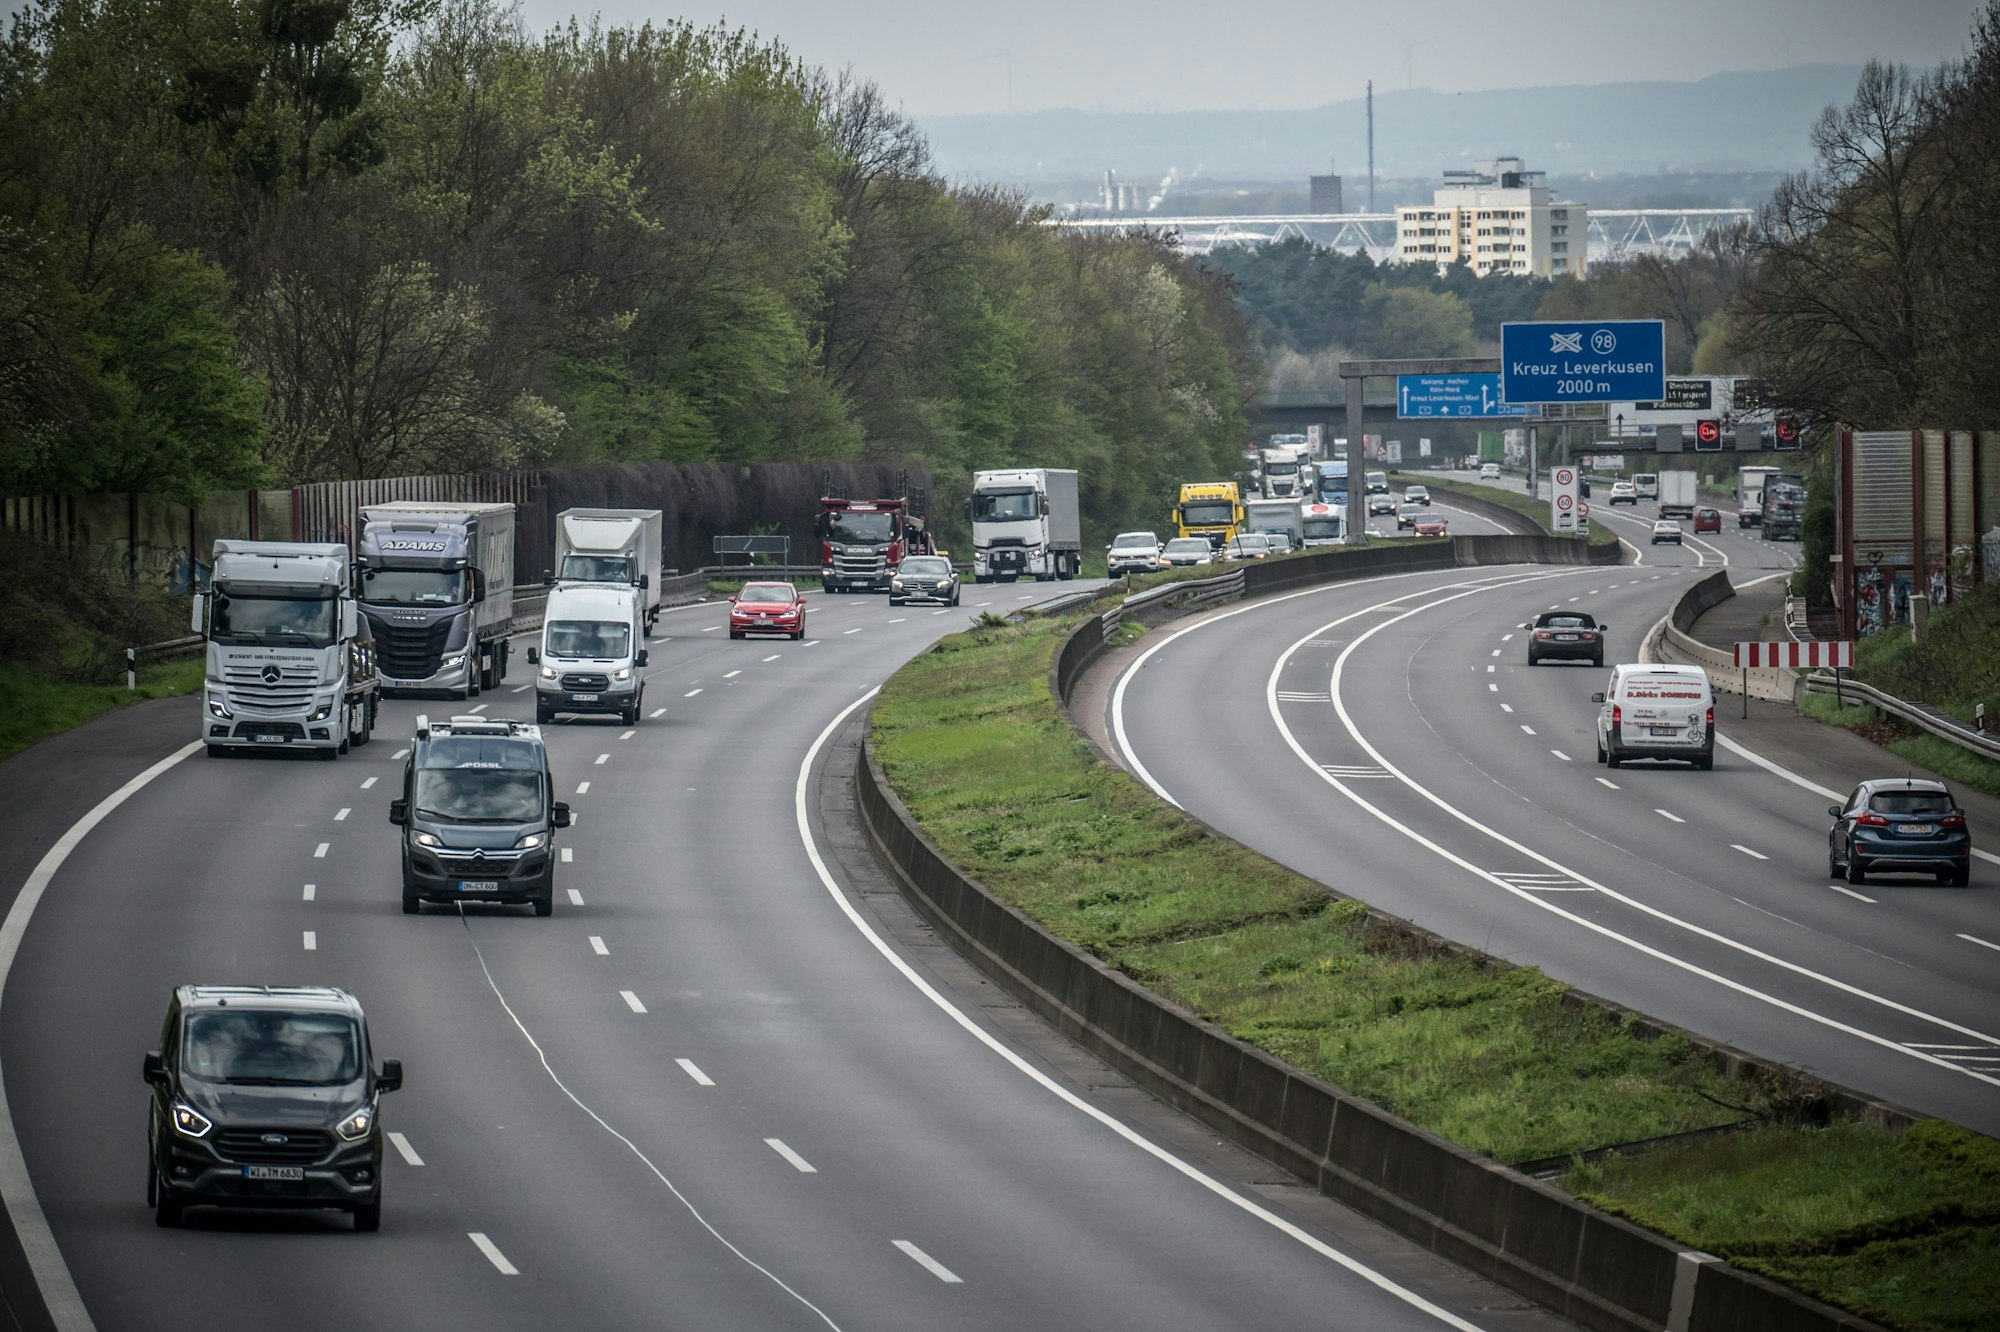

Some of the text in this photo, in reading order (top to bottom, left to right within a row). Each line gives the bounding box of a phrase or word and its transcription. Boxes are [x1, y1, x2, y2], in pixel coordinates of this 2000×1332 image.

[1595, 335, 1612, 349] 98
[1513, 360, 1654, 375] Kreuz Leverkusen
[1556, 379, 1611, 394] 2000 m
[1560, 473, 1569, 481] 80
[1560, 499, 1569, 507] 60
[380, 540, 446, 552] ADAMS
